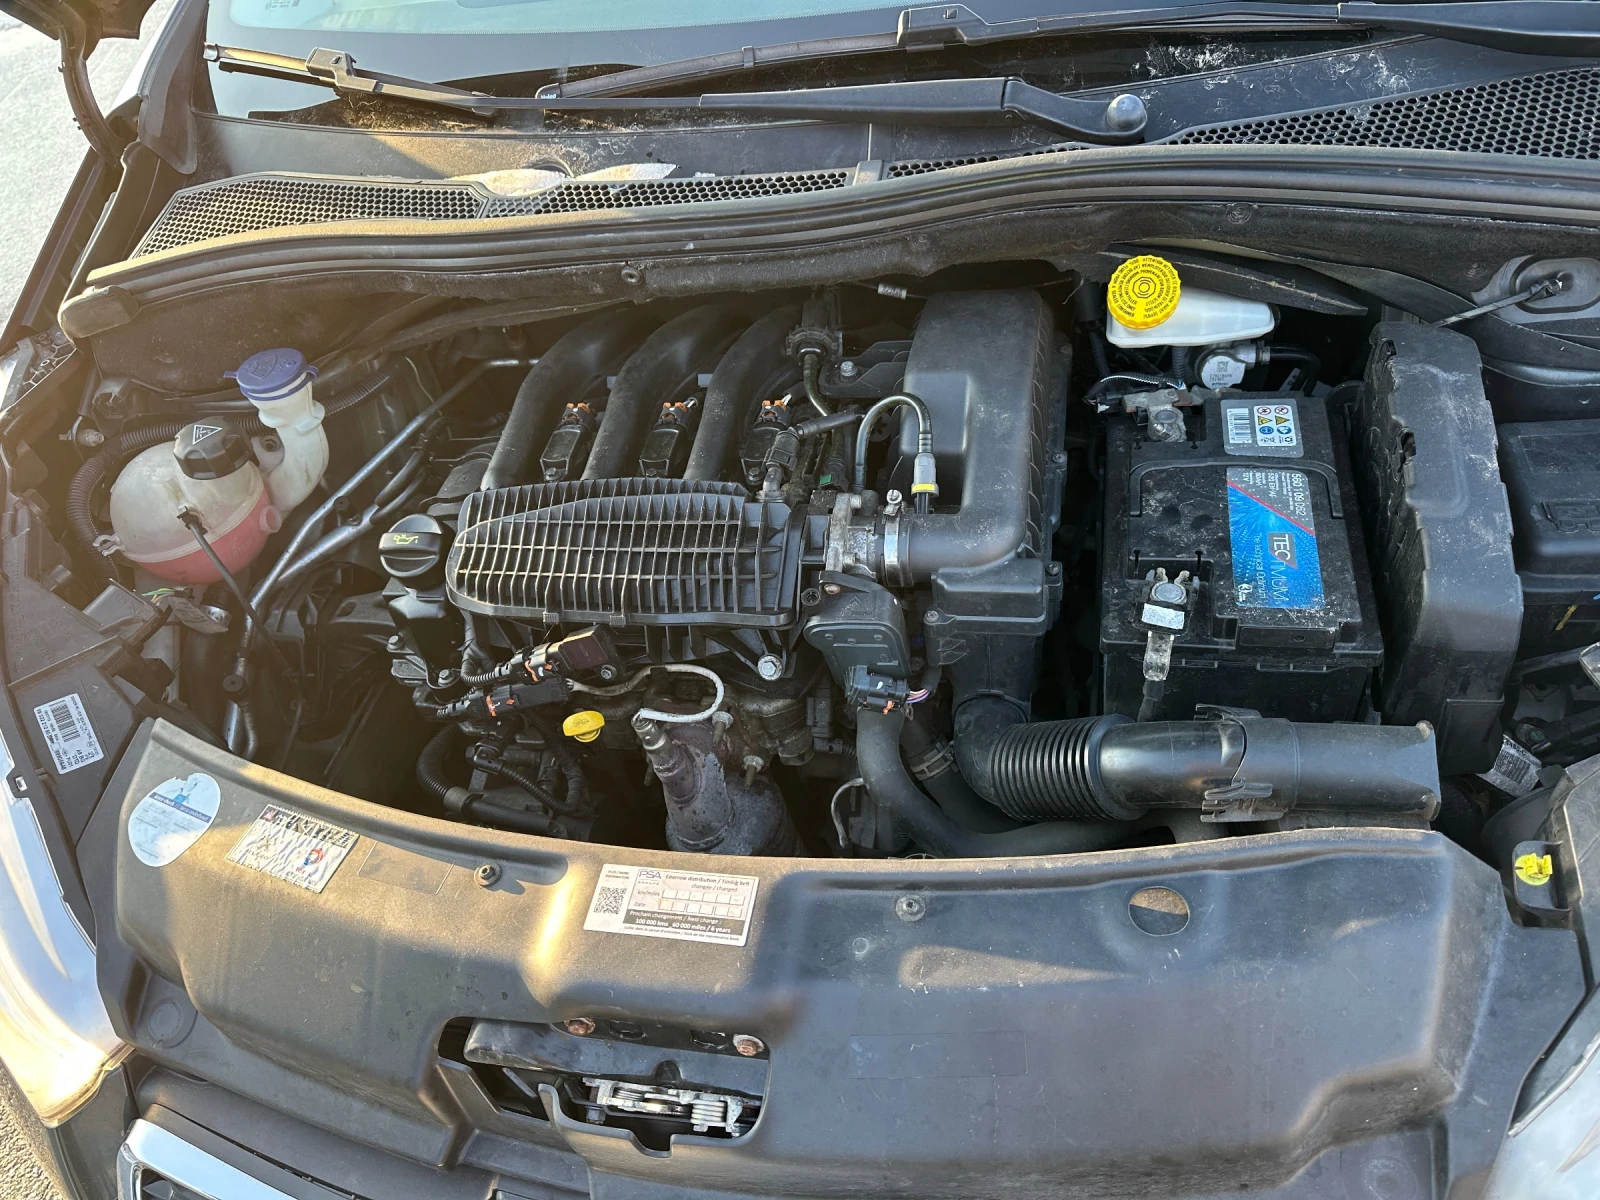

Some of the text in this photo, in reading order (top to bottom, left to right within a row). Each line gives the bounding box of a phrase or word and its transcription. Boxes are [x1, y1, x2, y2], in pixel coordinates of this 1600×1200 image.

[1117, 304, 1135, 317] CONTAINER
[1292, 473, 1302, 486] 560
[1294, 502, 1306, 515] 052
[638, 870, 662, 879] PSA
[652, 913, 683, 921] changement
